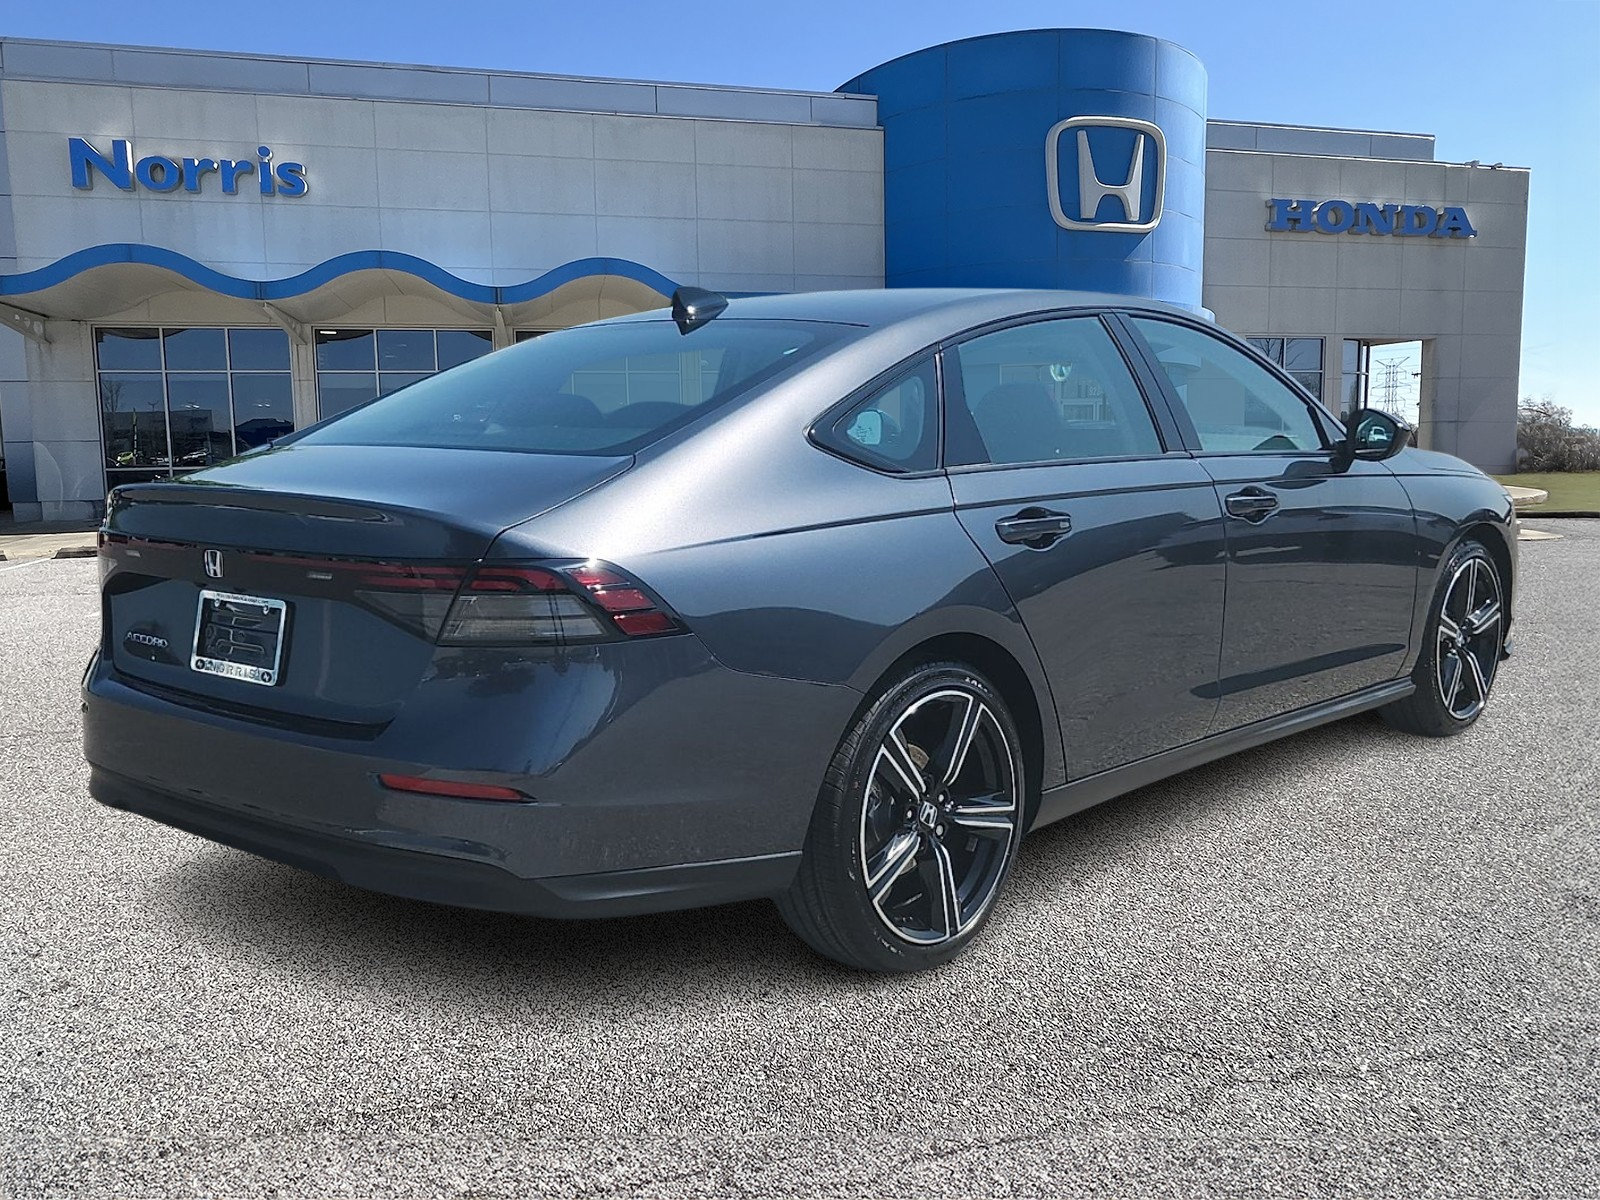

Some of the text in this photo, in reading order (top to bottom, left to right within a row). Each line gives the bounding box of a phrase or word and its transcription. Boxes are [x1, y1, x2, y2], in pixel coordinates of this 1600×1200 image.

[68, 137, 309, 197] Norris
[1265, 198, 1477, 239] HONDA
[125, 631, 169, 648] ACCORD
